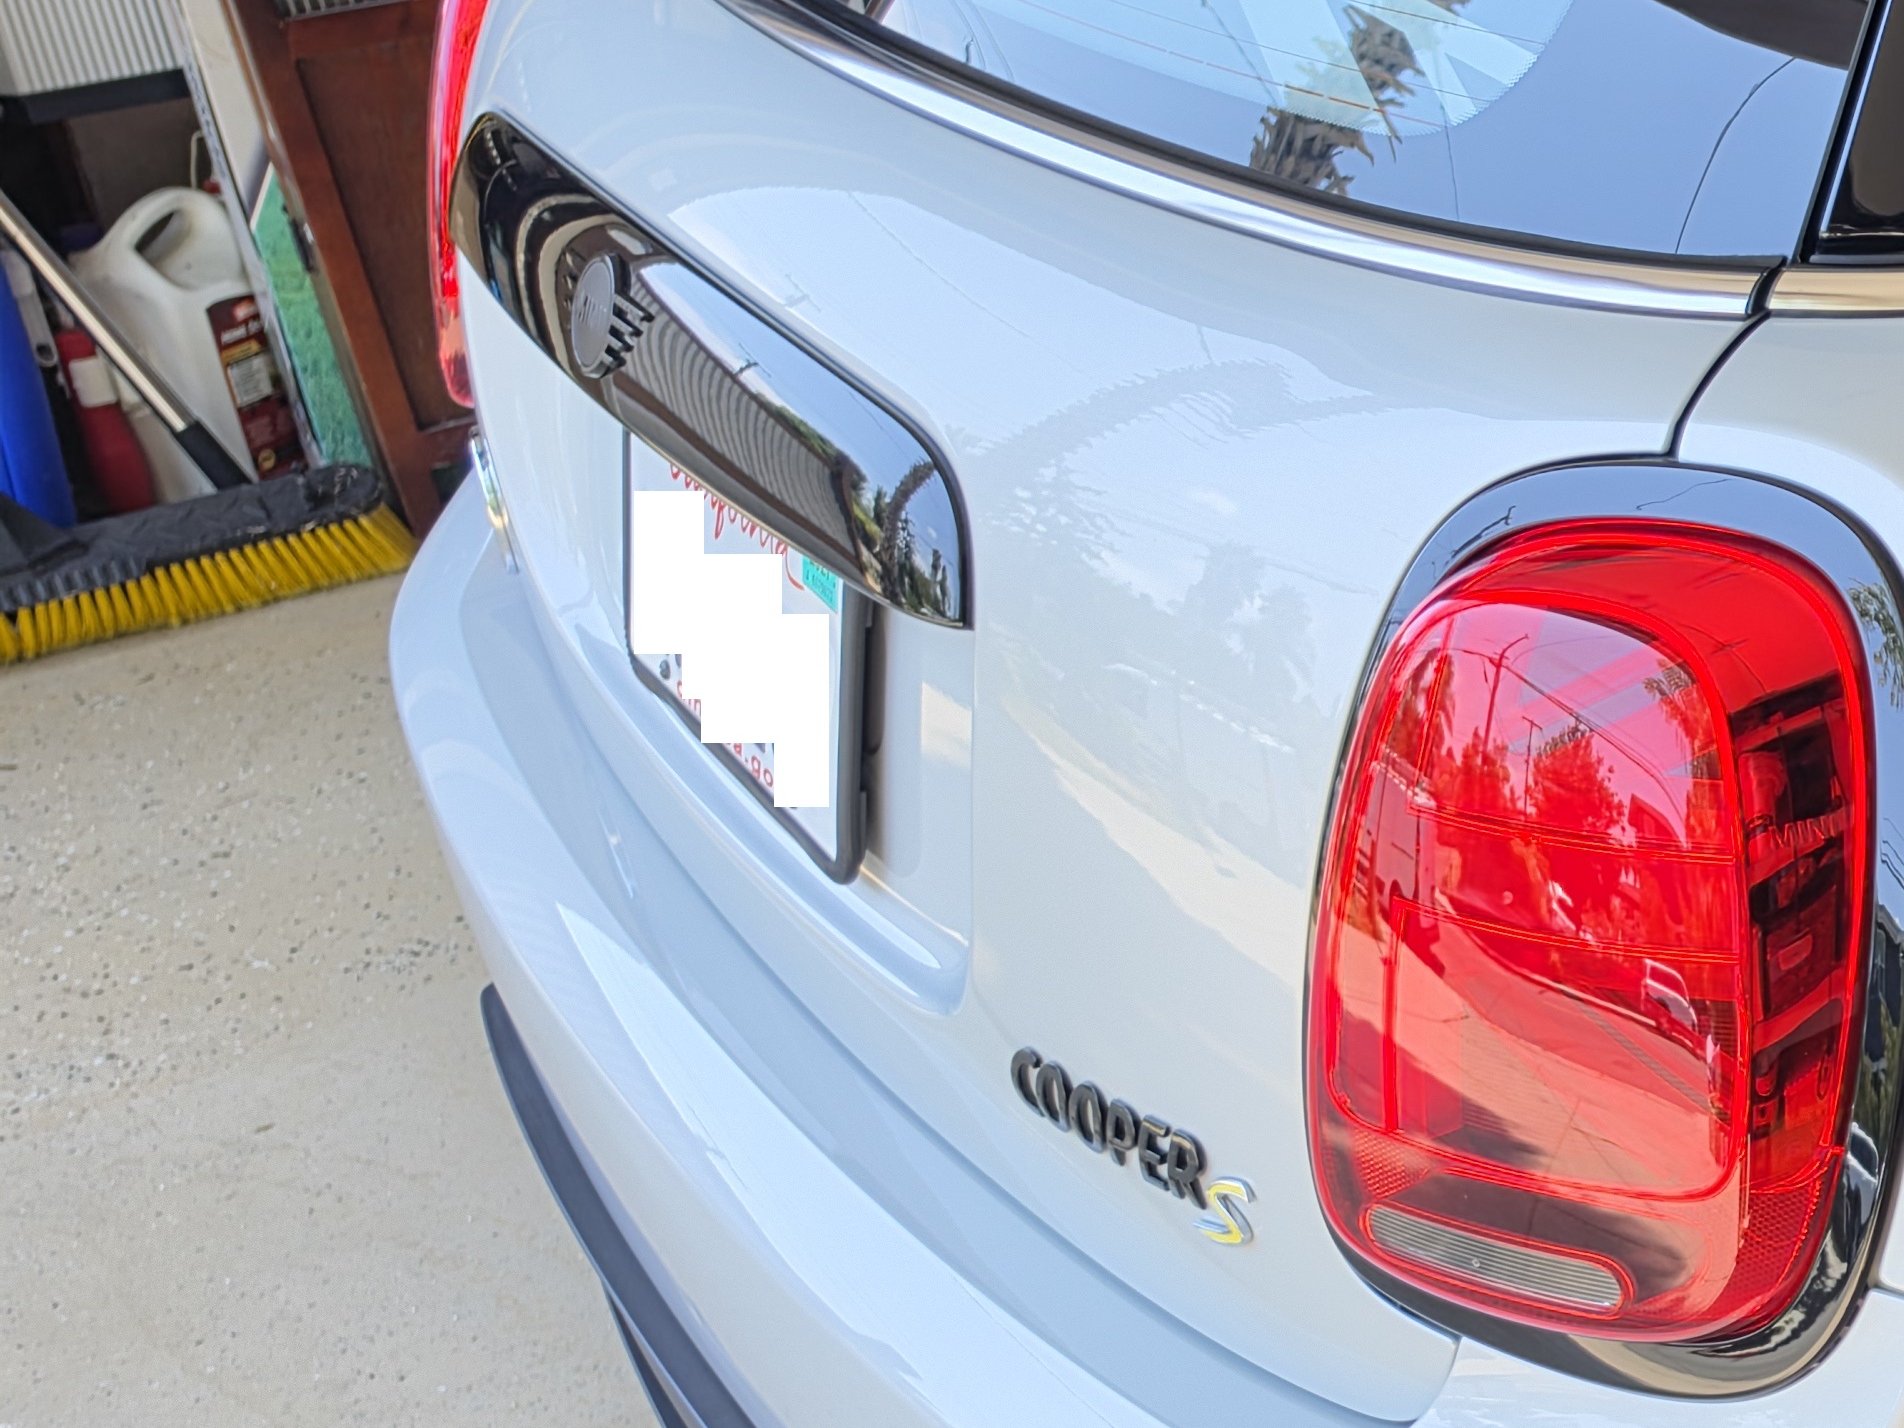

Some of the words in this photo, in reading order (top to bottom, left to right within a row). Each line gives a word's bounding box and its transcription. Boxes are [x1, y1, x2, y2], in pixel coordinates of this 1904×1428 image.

[1769, 815, 1837, 848] MINI
[1010, 1045, 1208, 1210] COOPER
[1192, 1175, 1258, 1246] S
